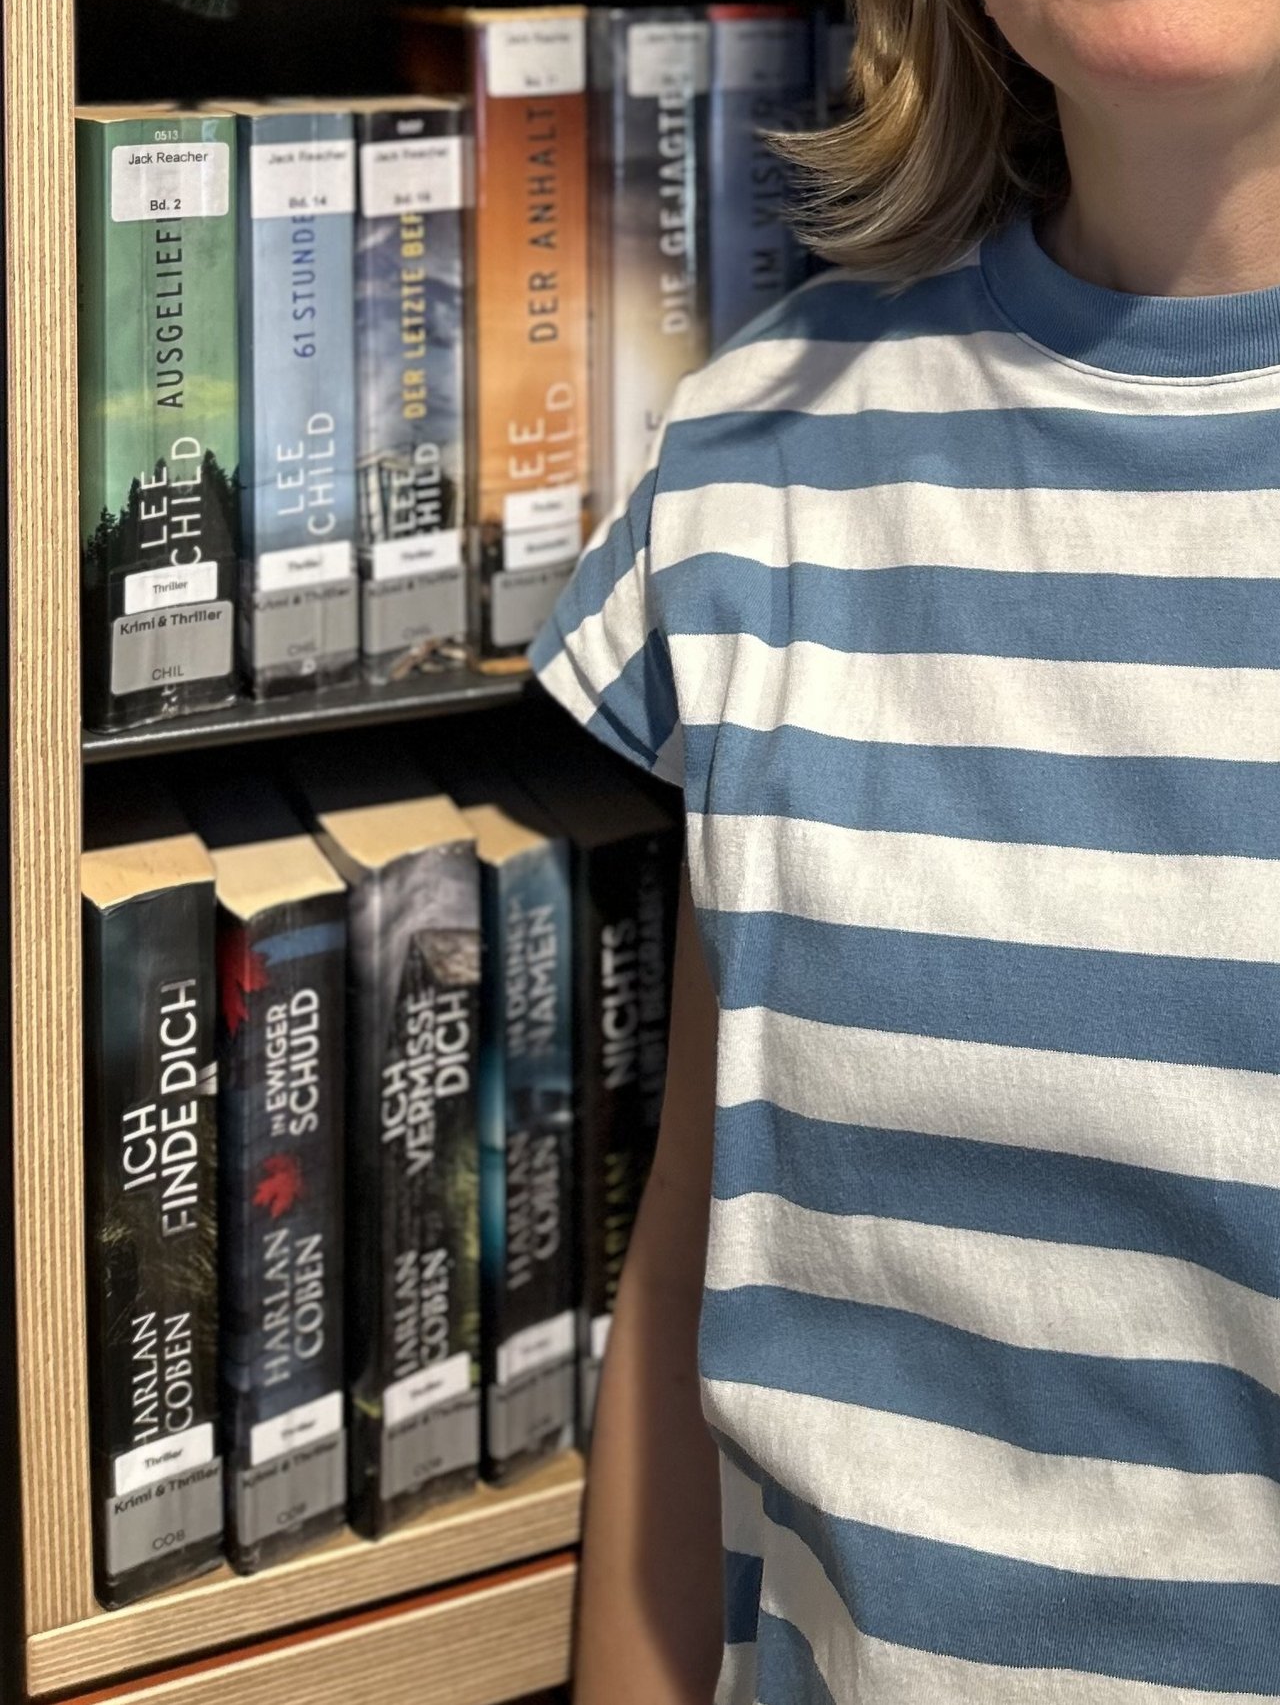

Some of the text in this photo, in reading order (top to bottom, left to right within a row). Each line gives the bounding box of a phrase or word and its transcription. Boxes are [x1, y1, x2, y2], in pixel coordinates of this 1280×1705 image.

[128, 151, 209, 165] Jack Reacher
[154, 130, 179, 141] 0513
[527, 104, 558, 251] ANHALT
[150, 199, 182, 211] Bd. 2
[656, 93, 693, 336] DIE GEJAGTE
[155, 217, 184, 408] AUSGELIEF
[400, 211, 427, 420] DER LETZTE BEF
[527, 270, 559, 345] DER
[277, 440, 305, 516] LEE
[307, 412, 336, 535] CHILD
[508, 417, 545, 481] EE
[140, 466, 168, 549] LEE
[171, 436, 202, 566] CHILD
[391, 465, 417, 541] LEE
[120, 610, 223, 636] Krimi & Thriller
[152, 581, 189, 594] Thriller
[151, 667, 185, 681] CHIL
[527, 904, 557, 1058] NAMEN
[602, 917, 638, 1090] NICHTS
[265, 1002, 288, 1137] IN EWIGER
[289, 988, 320, 1137] SCHULD
[405, 986, 436, 1177] VERMISSE
[435, 989, 470, 1098] DICH
[122, 1103, 158, 1192] ICH
[160, 978, 198, 1238] FINDE DICH
[380, 1060, 407, 1144] ICH
[263, 1227, 291, 1388] HARLAN
[294, 1233, 324, 1360] COBEN
[164, 1312, 193, 1434] COBEN
[114, 1468, 219, 1515] Krimi & Thriller
[144, 1448, 184, 1469] Thriller
[152, 1529, 186, 1551] COB
